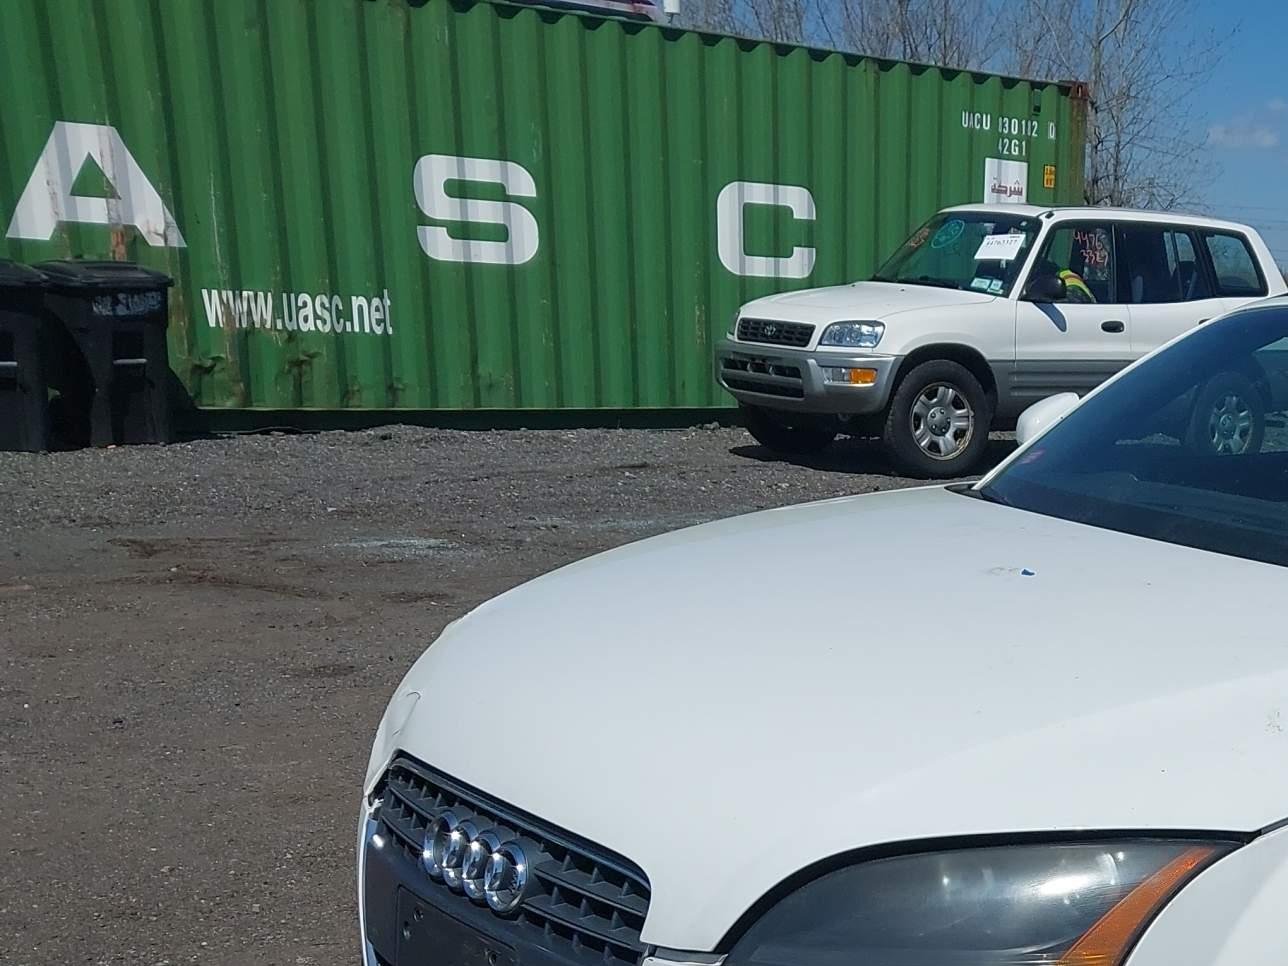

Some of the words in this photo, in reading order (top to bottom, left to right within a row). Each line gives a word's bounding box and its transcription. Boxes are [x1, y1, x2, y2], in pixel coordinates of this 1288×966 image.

[962, 111, 991, 130] UACU
[5, 120, 188, 248] A
[413, 153, 540, 265] S
[716, 181, 817, 279] C
[201, 287, 393, 335] www.uasc.net
